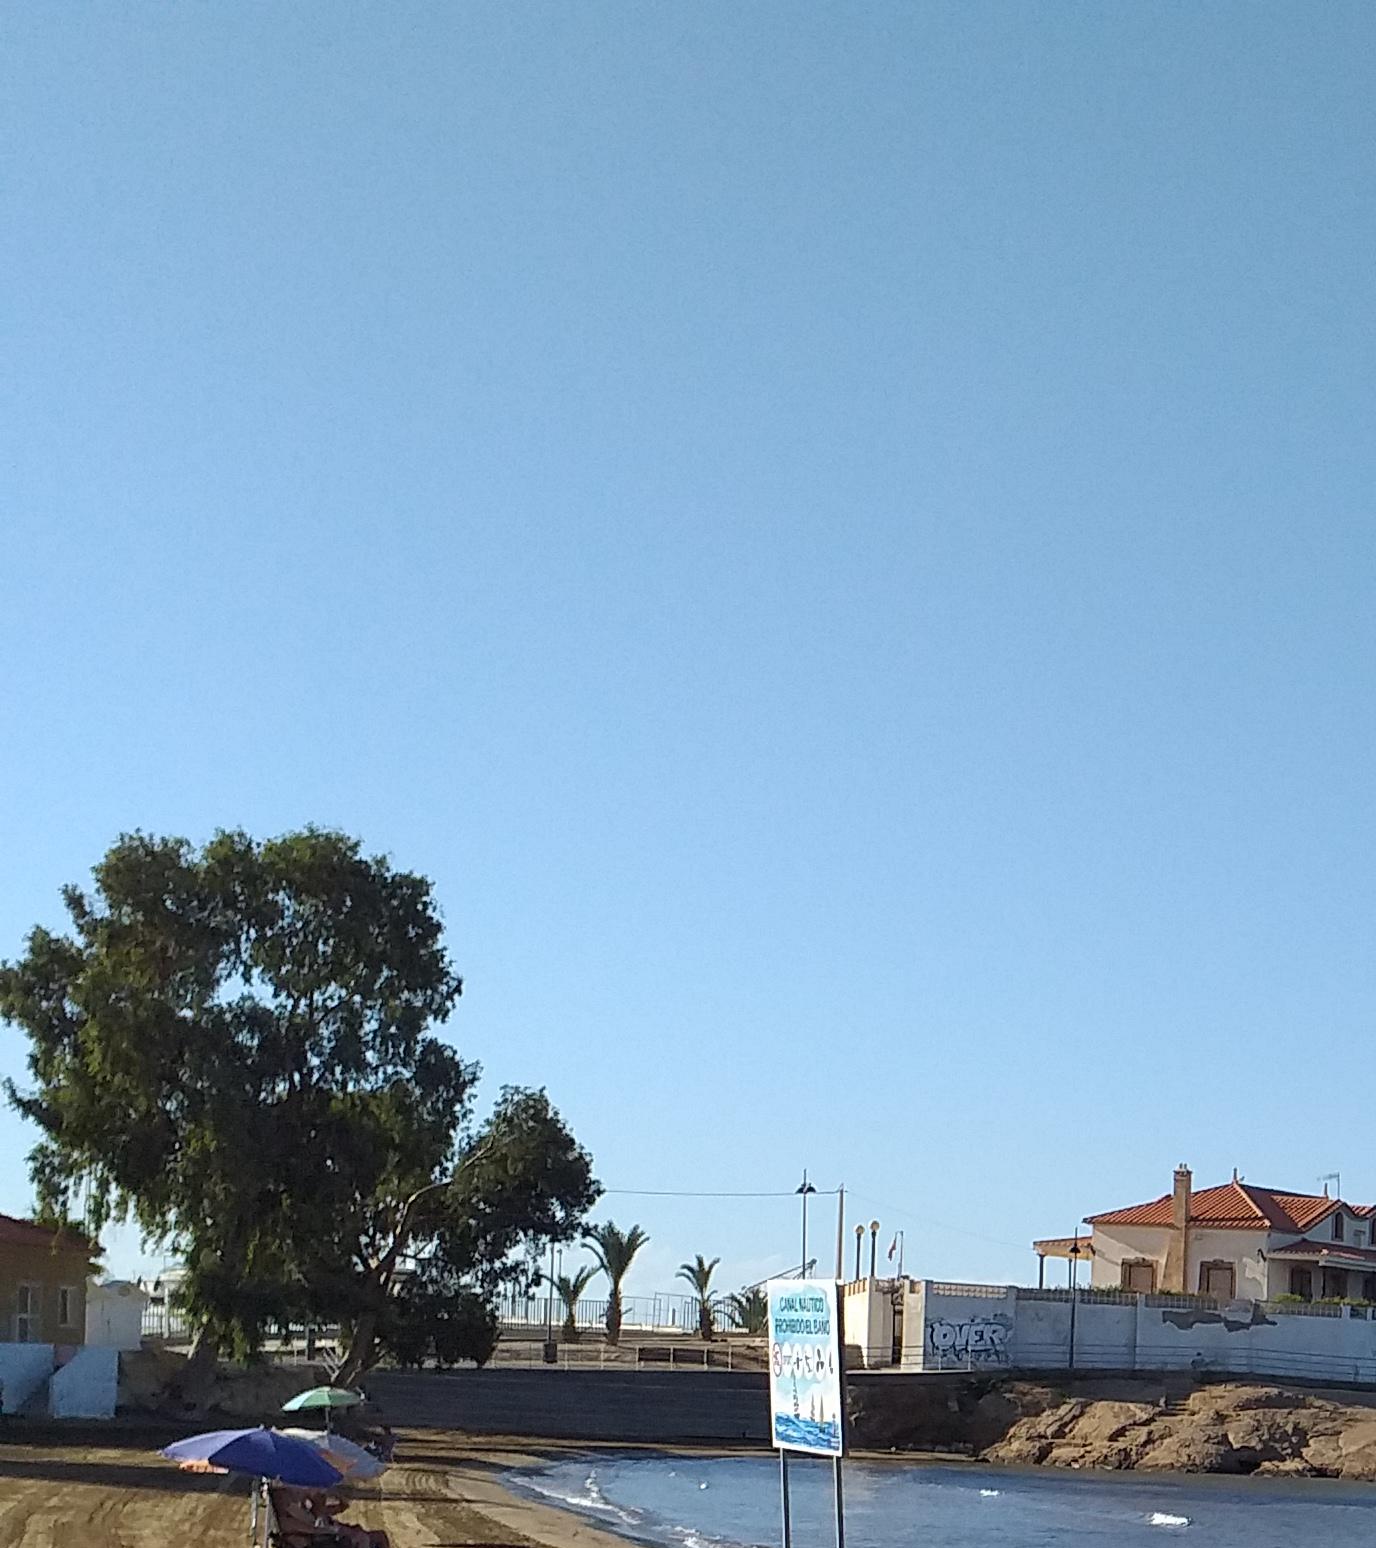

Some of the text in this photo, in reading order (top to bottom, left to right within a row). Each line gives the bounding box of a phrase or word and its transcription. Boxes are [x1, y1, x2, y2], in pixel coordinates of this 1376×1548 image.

[780, 1297, 798, 1312] CANAL
[775, 1318, 804, 1334] PROHIBIDO
[805, 1319, 813, 1334] EL
